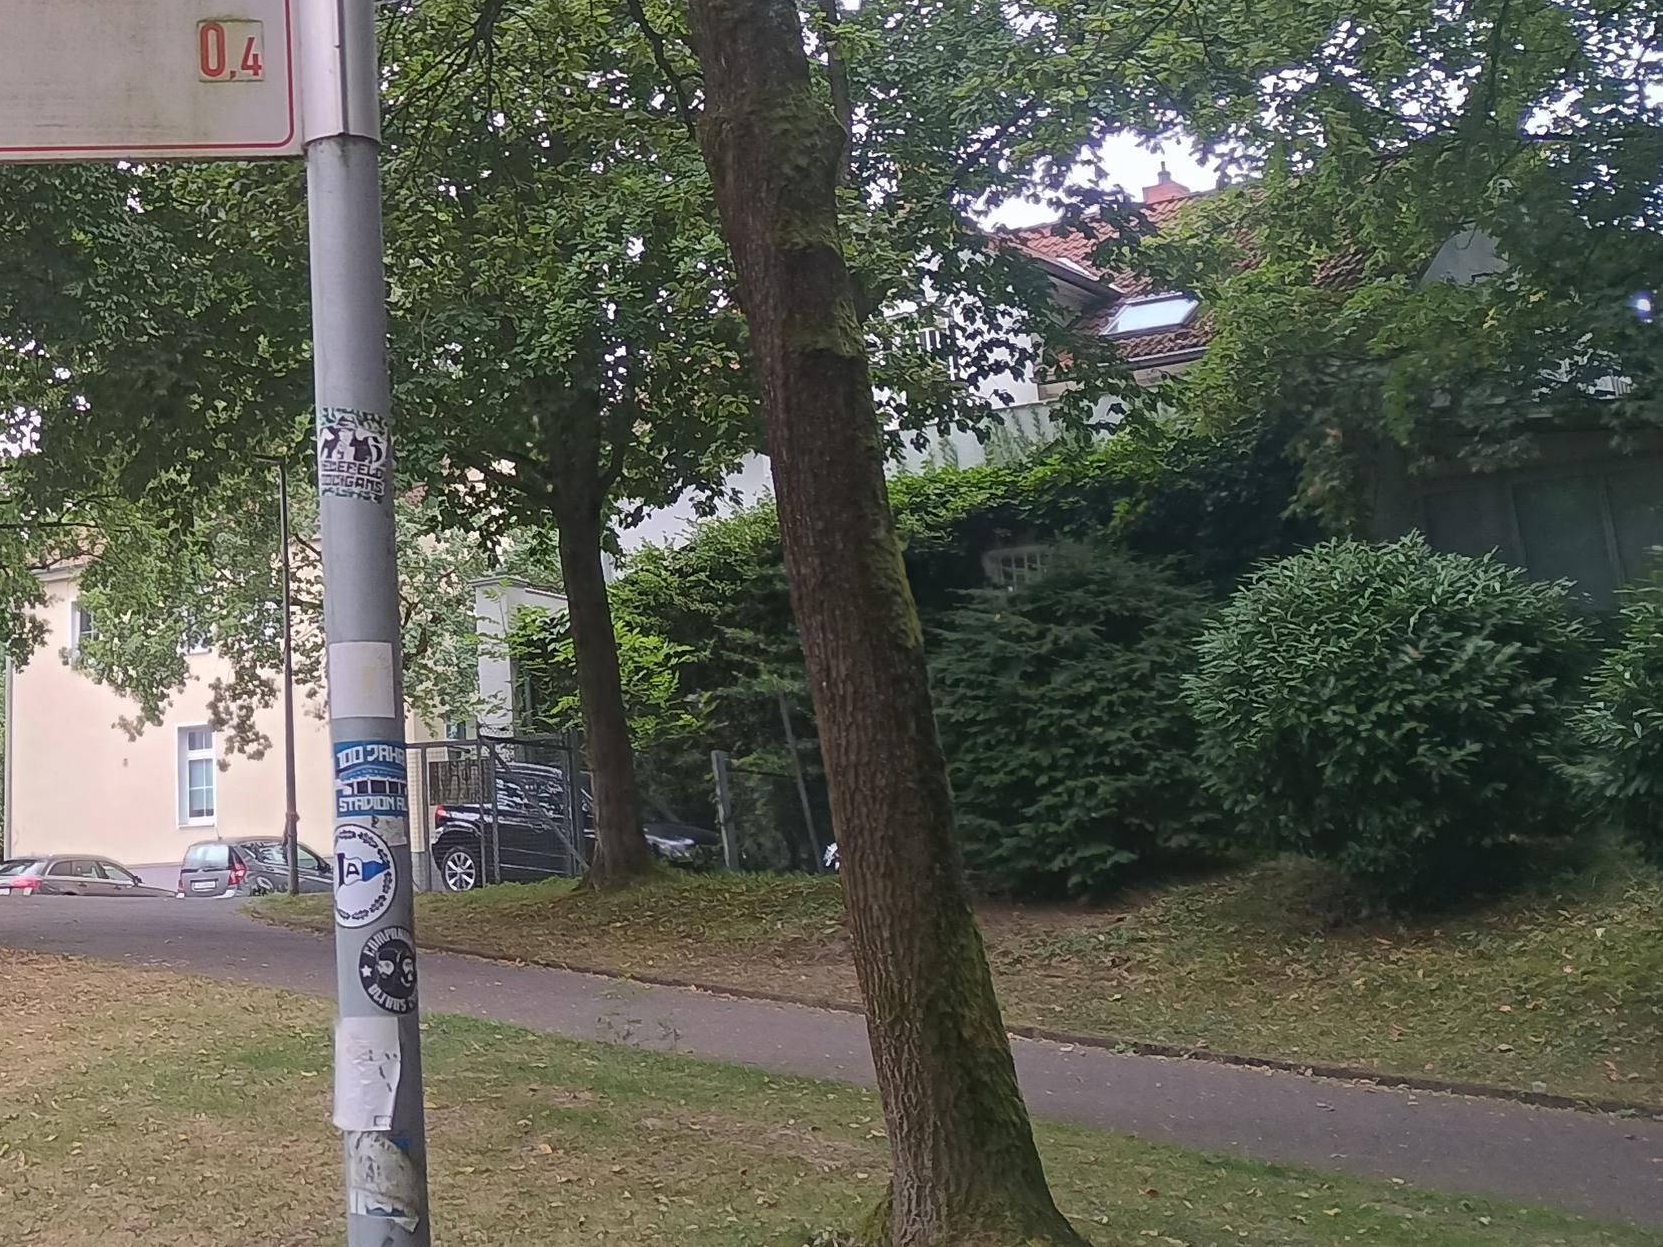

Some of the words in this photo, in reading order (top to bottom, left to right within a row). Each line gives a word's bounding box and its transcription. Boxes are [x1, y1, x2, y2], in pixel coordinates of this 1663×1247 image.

[199, 23, 262, 80] 0,4
[337, 746, 364, 769] 100
[339, 796, 395, 812] STADION
